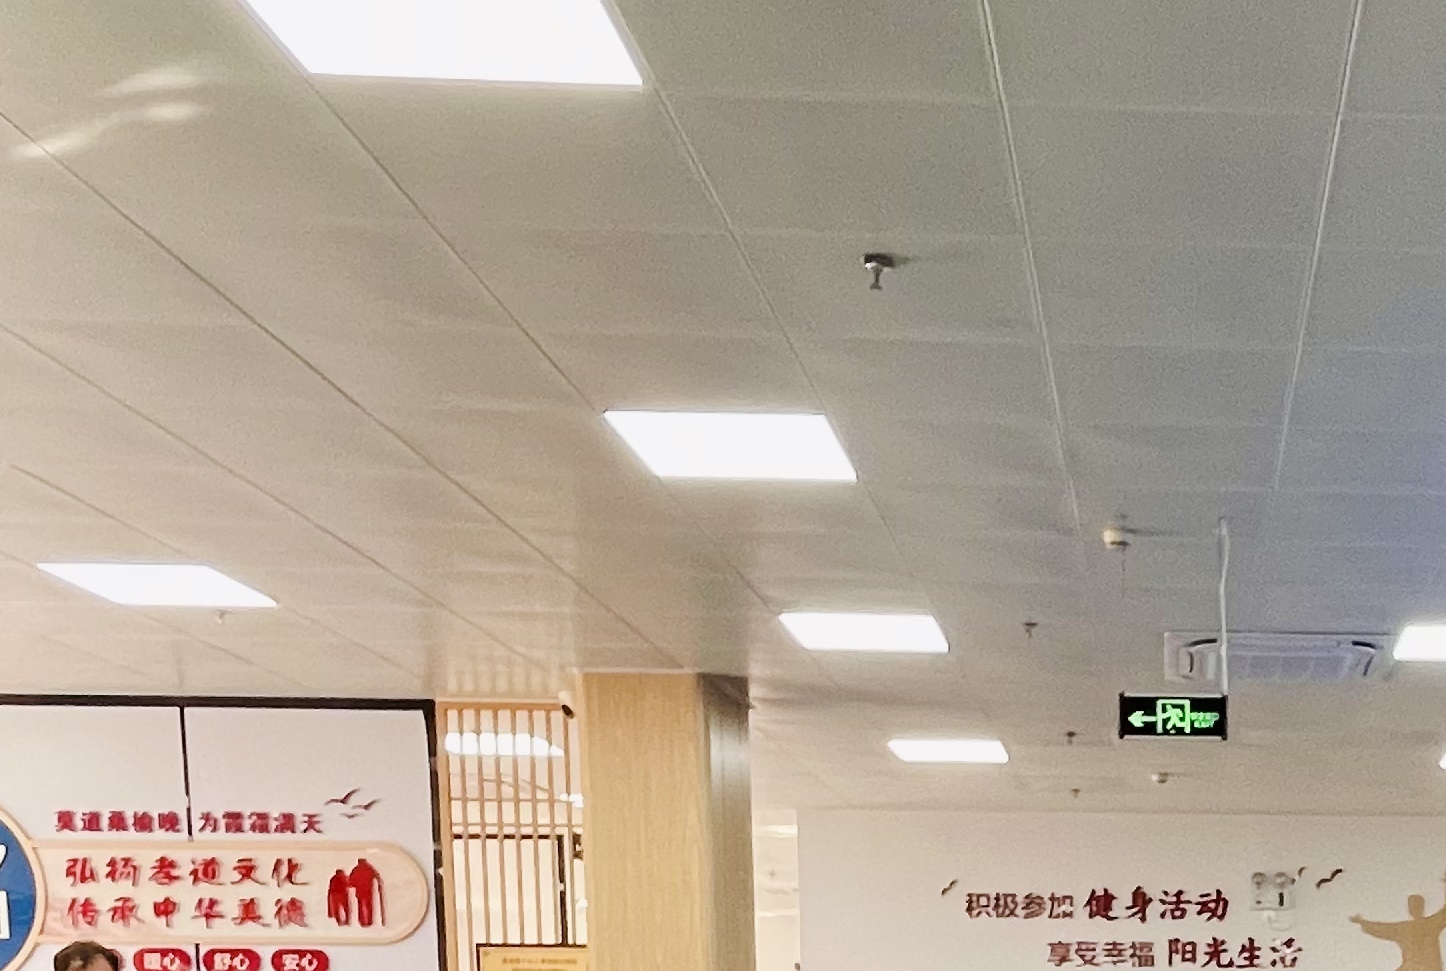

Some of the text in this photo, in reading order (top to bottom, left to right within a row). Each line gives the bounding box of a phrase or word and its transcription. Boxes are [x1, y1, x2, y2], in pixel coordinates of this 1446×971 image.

[65, 857, 308, 887] 弘扬孝道文化
[67, 897, 308, 929] 传承中华美德
[966, 887, 1229, 923] 积极参加 健身活动
[1047, 936, 1302, 969] 享受幸福 阳光生活
